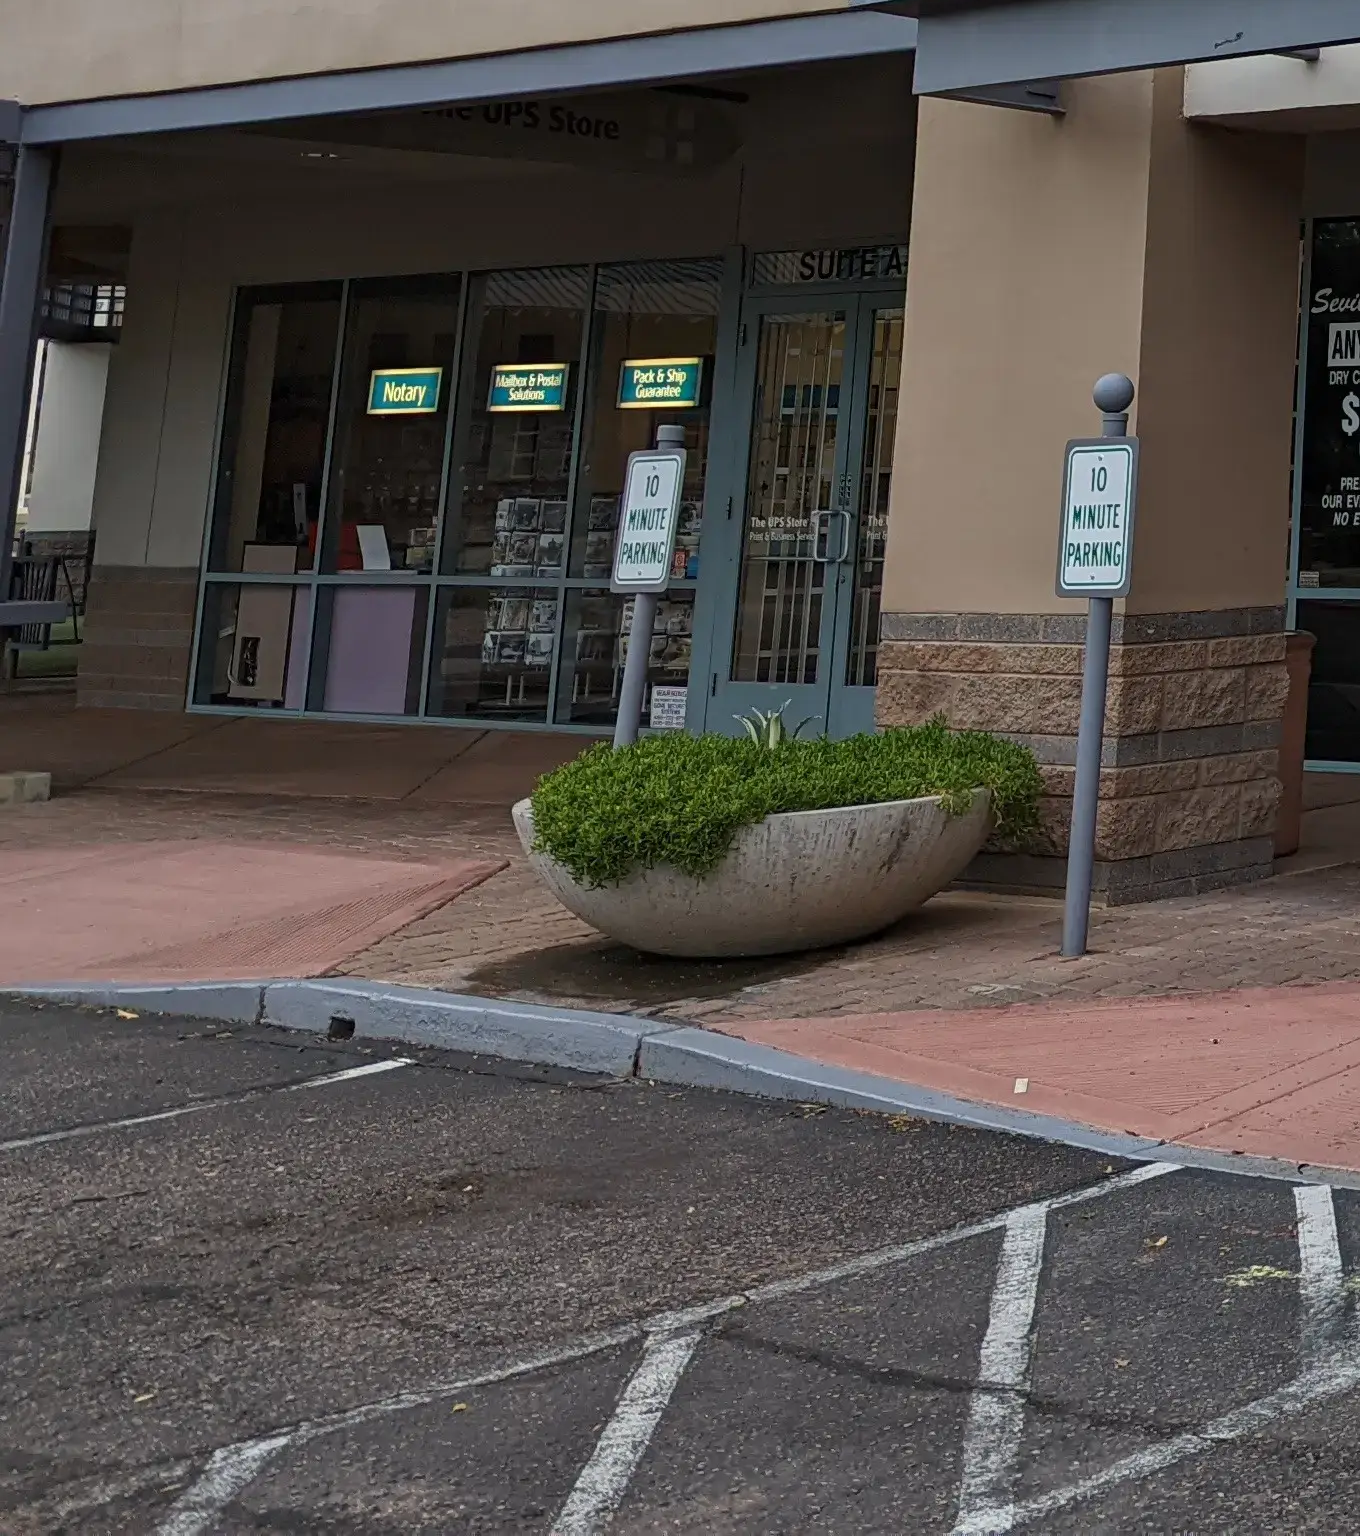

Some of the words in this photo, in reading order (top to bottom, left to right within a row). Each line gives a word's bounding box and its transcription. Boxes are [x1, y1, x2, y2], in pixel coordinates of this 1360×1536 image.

[484, 101, 540, 128] UPS
[549, 107, 619, 140] Store
[800, 248, 876, 281] SUITE
[495, 374, 527, 388] Mailbox
[528, 373, 537, 387] &
[537, 372, 563, 387] Postal
[633, 369, 656, 384] Pack
[656, 368, 665, 383] &
[666, 367, 687, 385] Ship
[1328, 370, 1350, 386] DRY
[383, 381, 427, 407] Notary
[508, 387, 546, 401] Solutions
[635, 384, 682, 399] Guarantee
[645, 475, 660, 497] 10
[1091, 467, 1107, 492] 10
[1321, 494, 1343, 509] OUR
[627, 507, 668, 531] MINUTE
[751, 516, 766, 528] The
[768, 516, 785, 528] UPS
[786, 516, 808, 528] Store
[867, 515, 883, 527] The
[1071, 503, 1121, 530] MINUTE
[1333, 512, 1349, 526] NO
[621, 541, 665, 565] PARKING
[1066, 541, 1122, 568] PARKING
